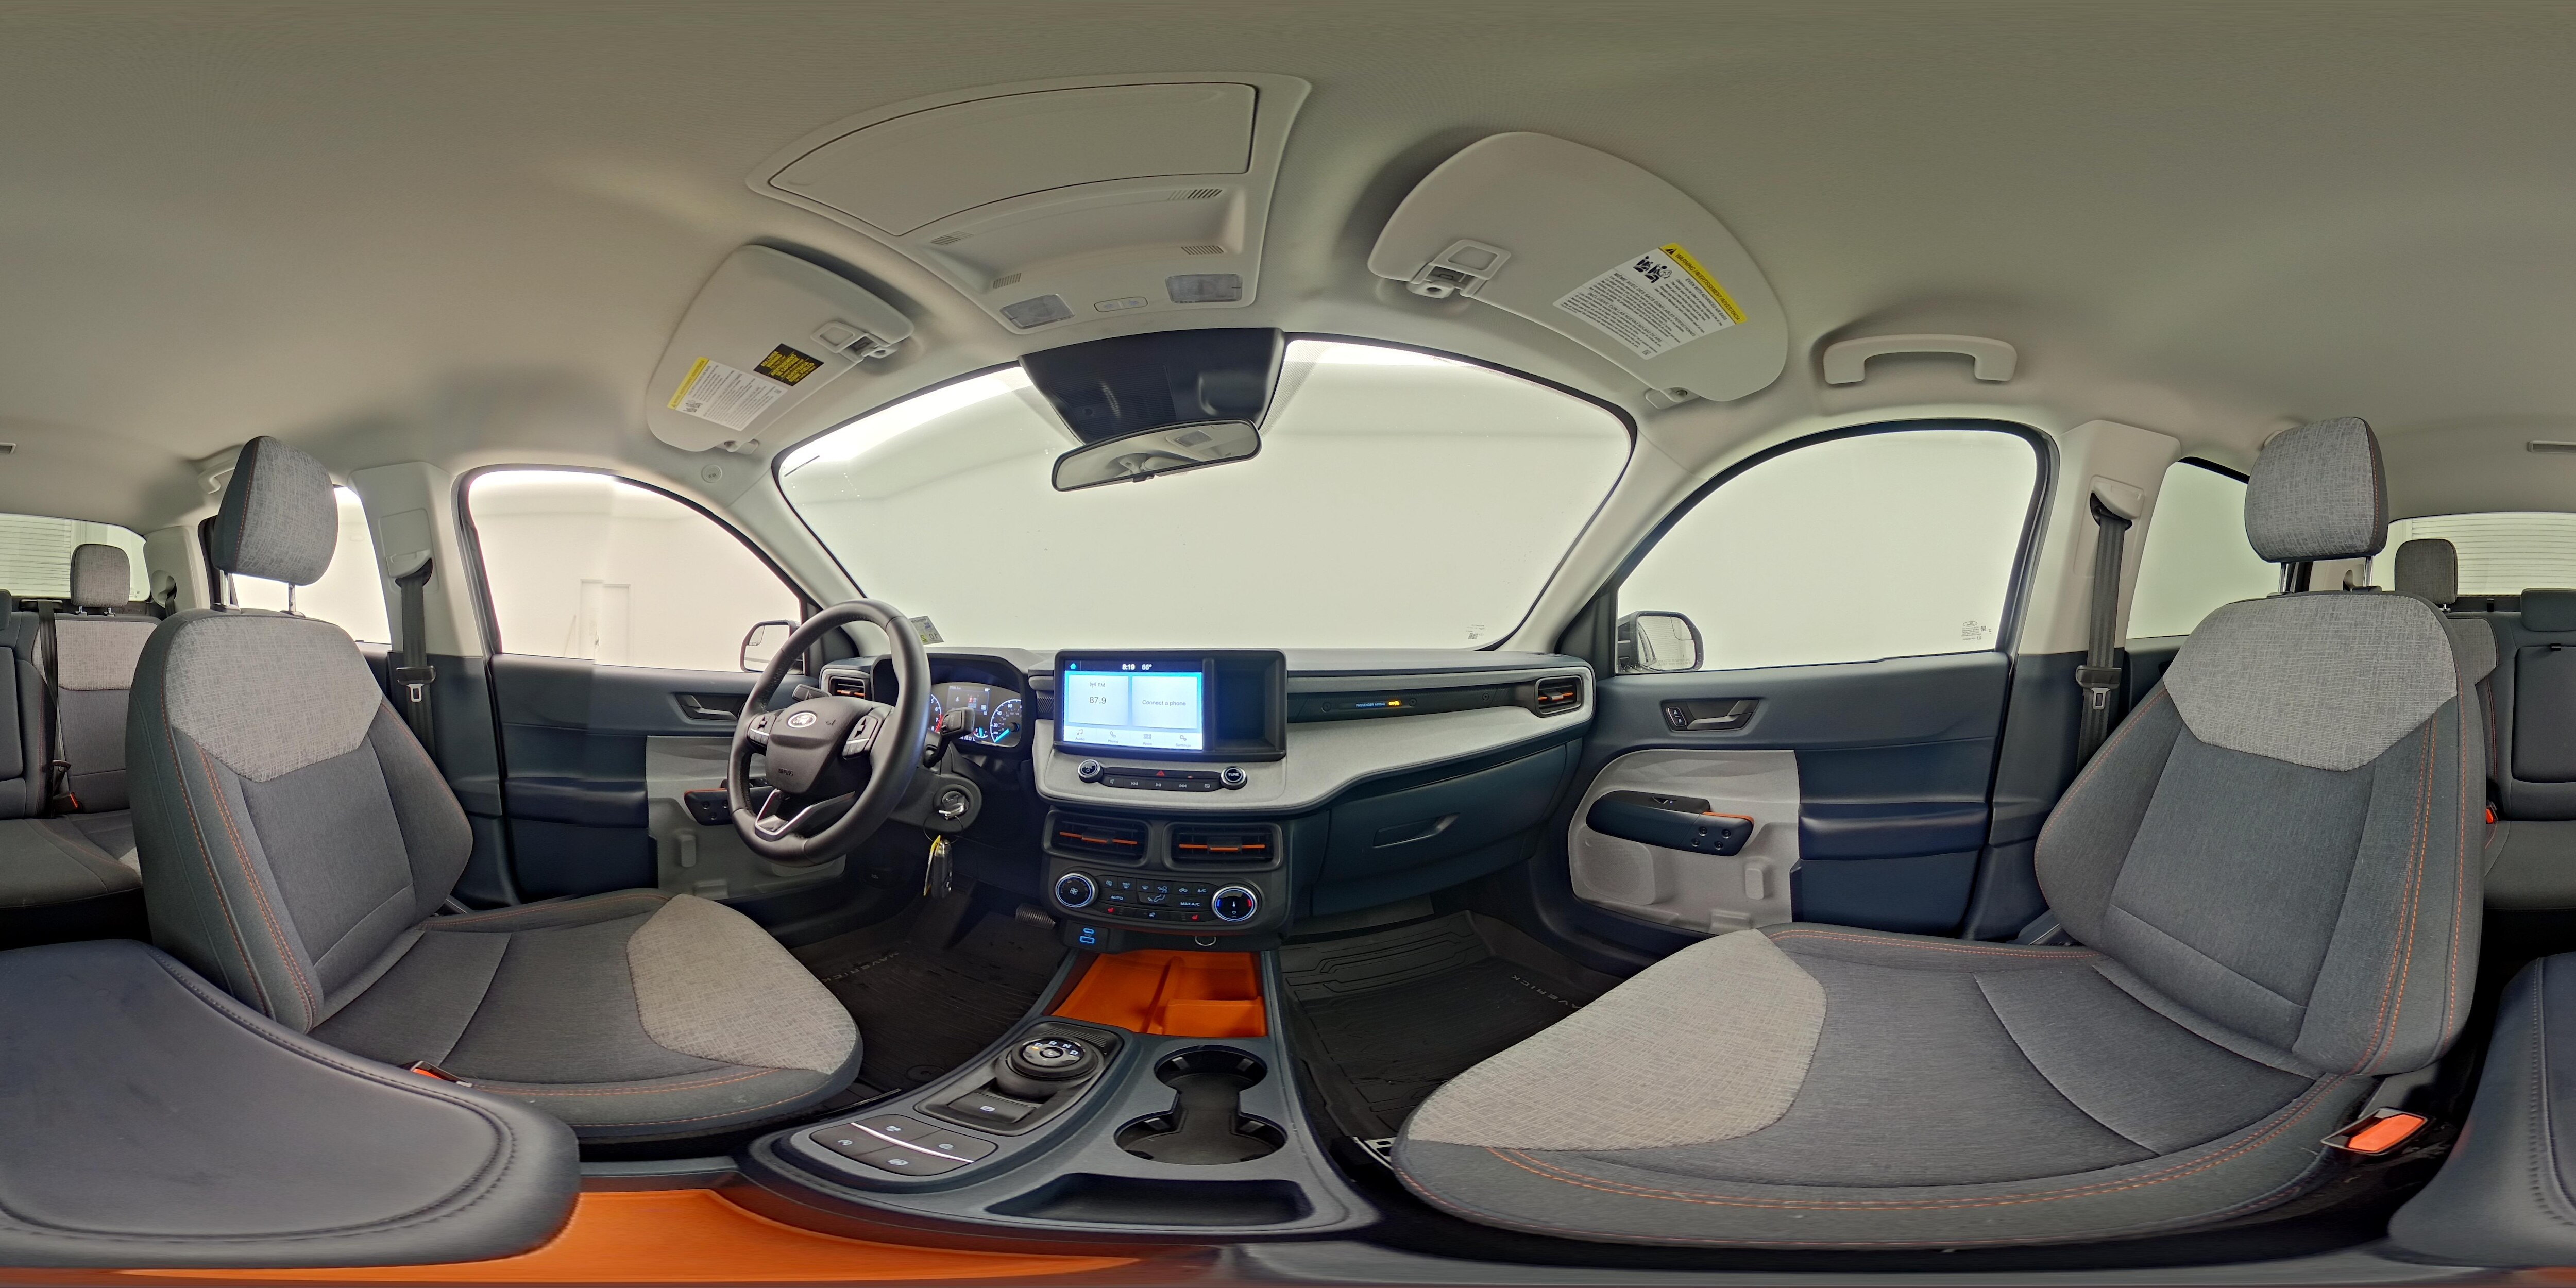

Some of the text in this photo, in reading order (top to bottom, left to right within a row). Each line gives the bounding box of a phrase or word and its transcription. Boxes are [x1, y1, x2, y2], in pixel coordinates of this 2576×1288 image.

[1674, 252, 1696, 271] WARNING
[1684, 278, 1696, 287] EVEN
[1693, 285, 1703, 294] WITH
[1512, 975, 1582, 1009] AVERICK
